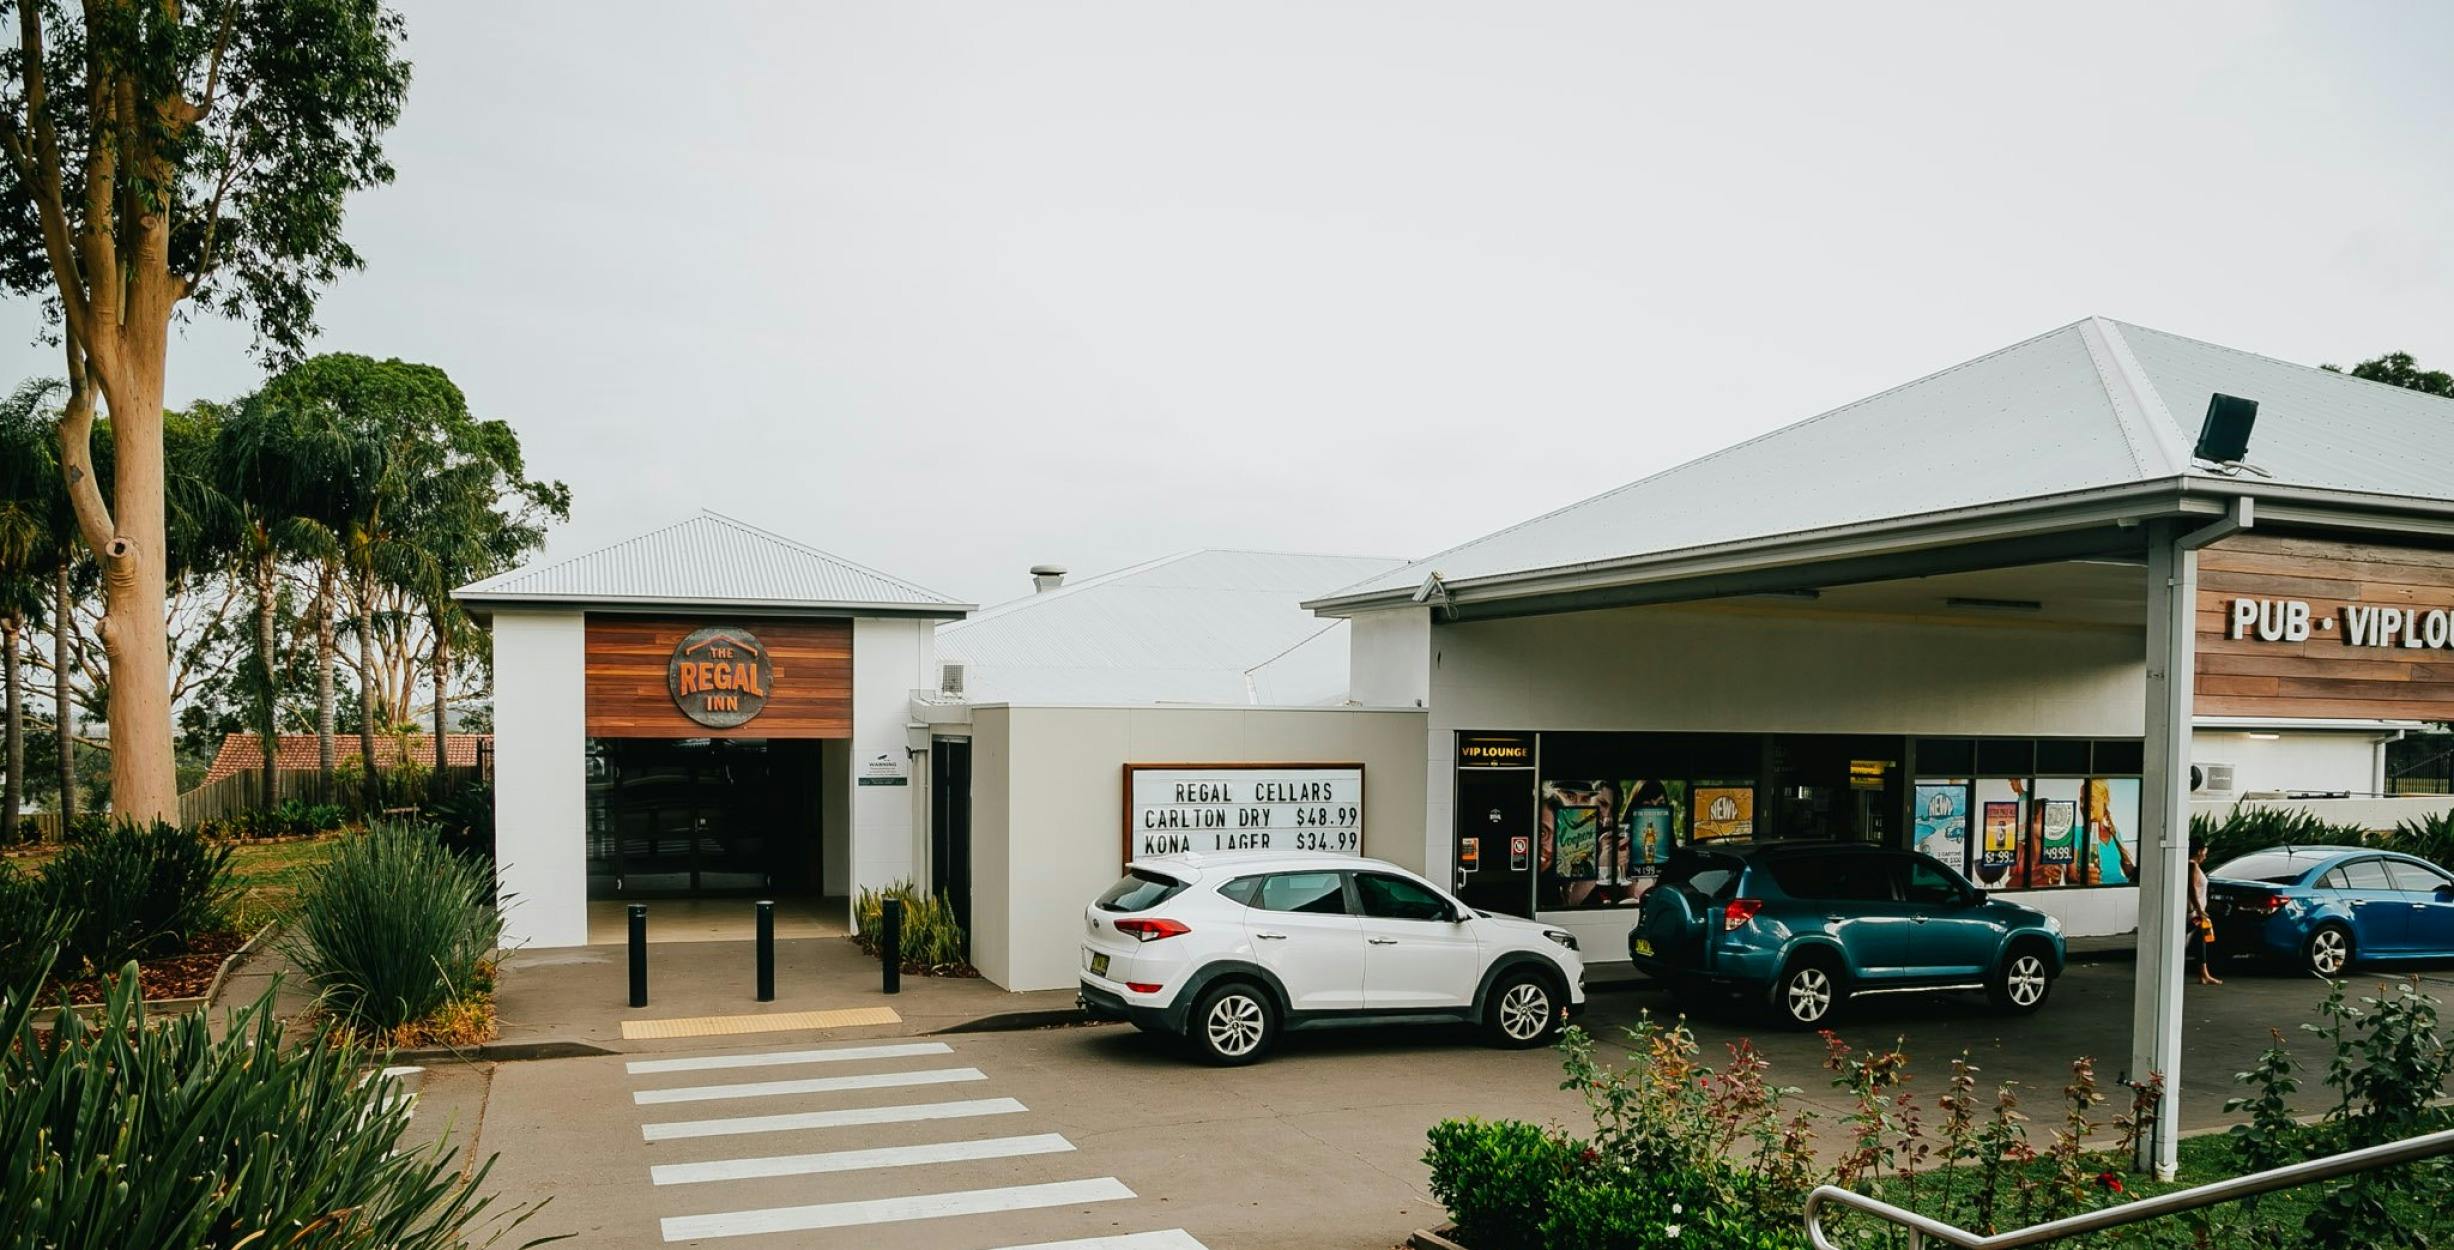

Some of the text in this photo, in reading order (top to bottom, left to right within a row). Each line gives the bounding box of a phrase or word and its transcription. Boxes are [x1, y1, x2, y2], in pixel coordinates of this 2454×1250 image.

[2233, 598, 2310, 641] PUB
[710, 647, 734, 659] THE
[680, 662, 764, 697] REGAL
[707, 696, 738, 711] INN
[1462, 747, 1528, 757] VIP LOUNGE
[1176, 782, 1332, 802] REGAL CELLARS
[1145, 807, 1357, 828] CARLTON DRY $48.99
[1145, 834, 1190, 854] KONA
[1296, 832, 1357, 850] $34.99
